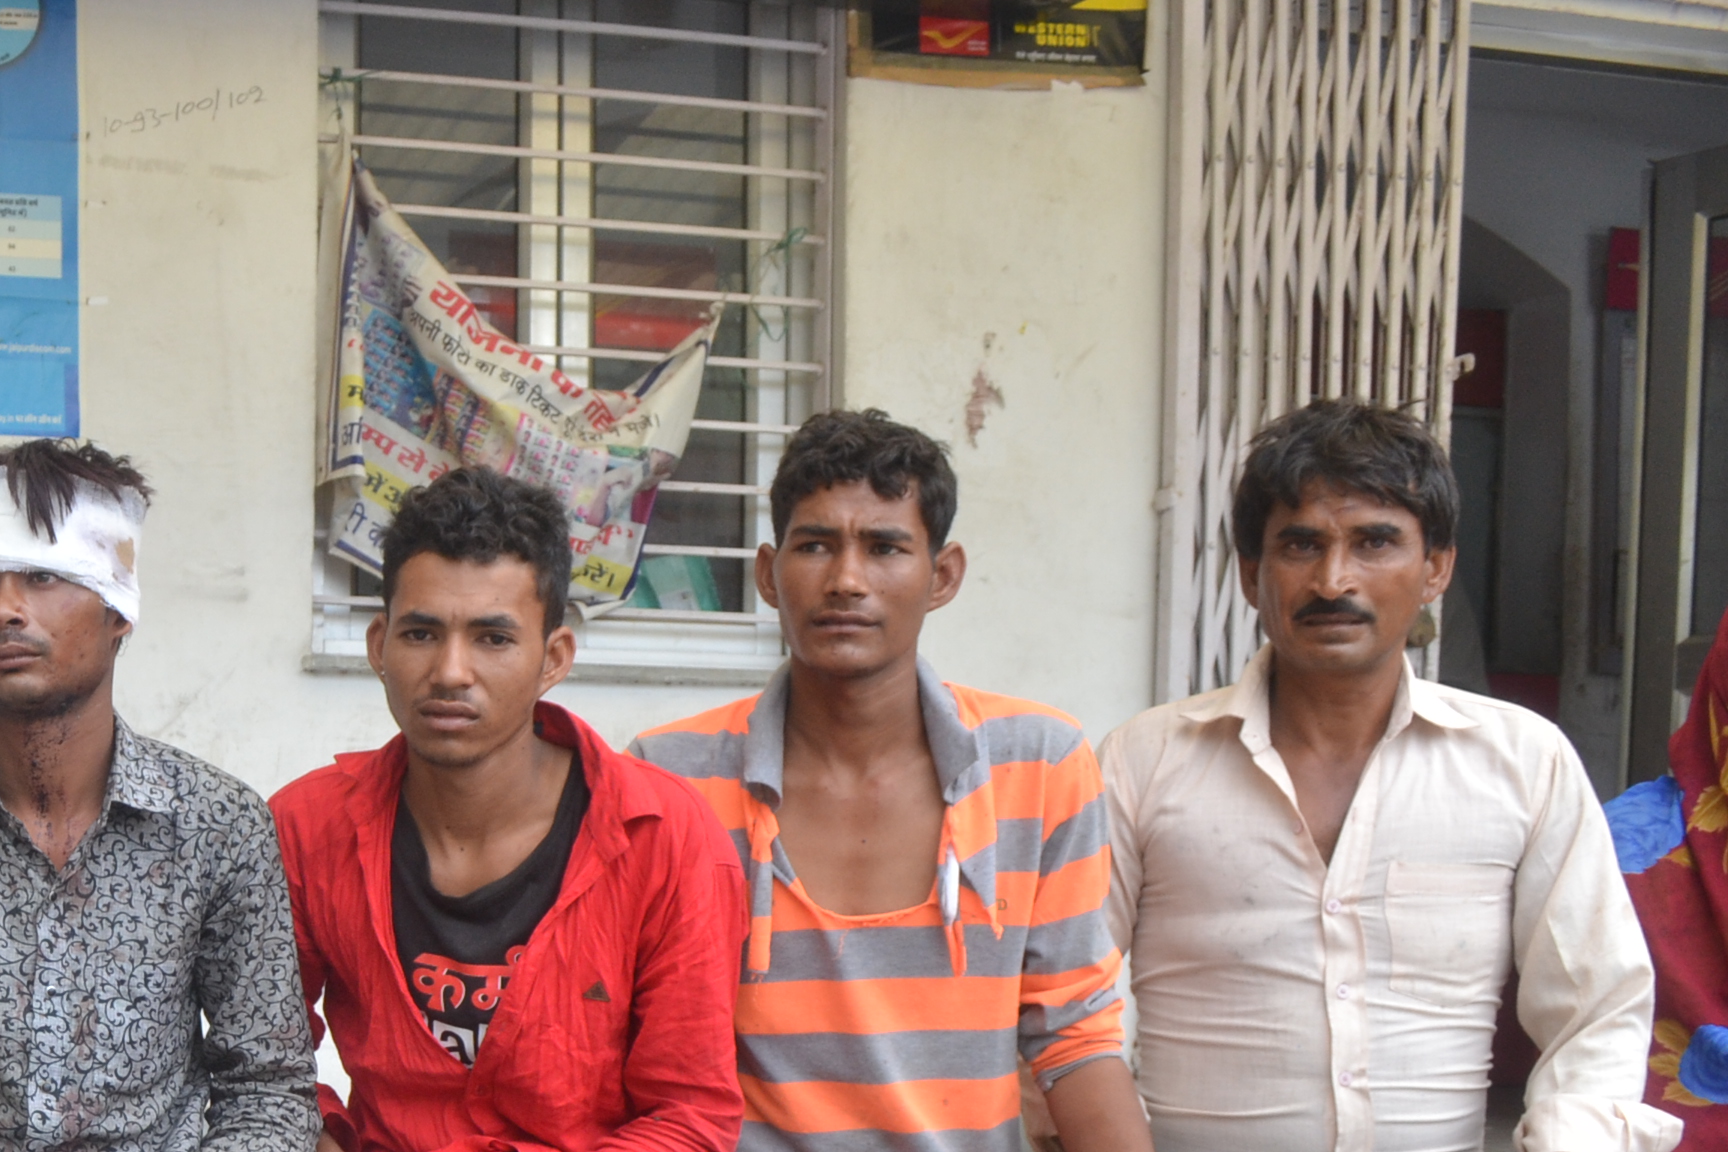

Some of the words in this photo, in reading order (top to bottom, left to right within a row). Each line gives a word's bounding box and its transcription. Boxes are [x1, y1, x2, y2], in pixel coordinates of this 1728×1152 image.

[1036, 34, 1088, 47] UNION
[475, 358, 497, 376] का
[500, 365, 529, 396] डाक
[525, 384, 564, 424] टिकट
